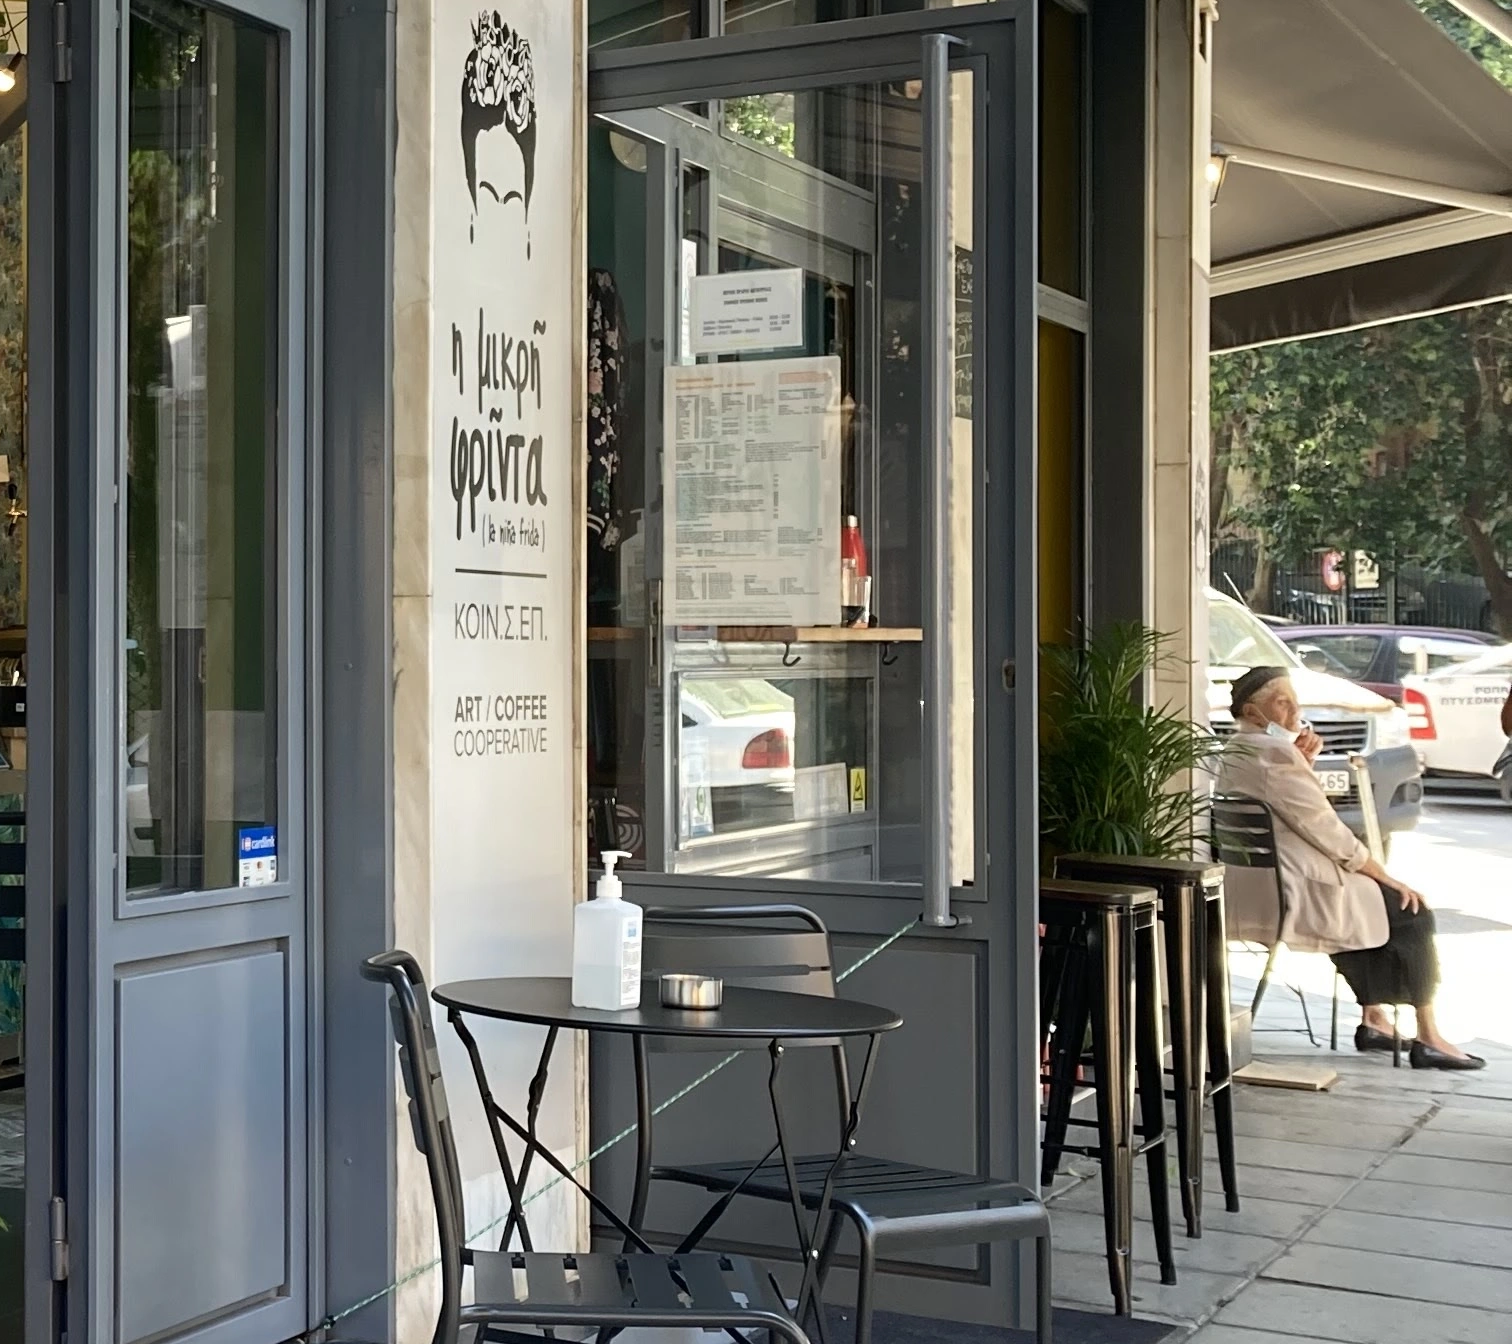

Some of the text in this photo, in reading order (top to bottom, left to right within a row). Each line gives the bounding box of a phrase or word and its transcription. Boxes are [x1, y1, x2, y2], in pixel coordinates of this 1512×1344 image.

[499, 518, 516, 545] niña
[454, 695, 483, 723] ART
[494, 694, 548, 722] COFFEE
[453, 727, 548, 758] COOPERATIVE
